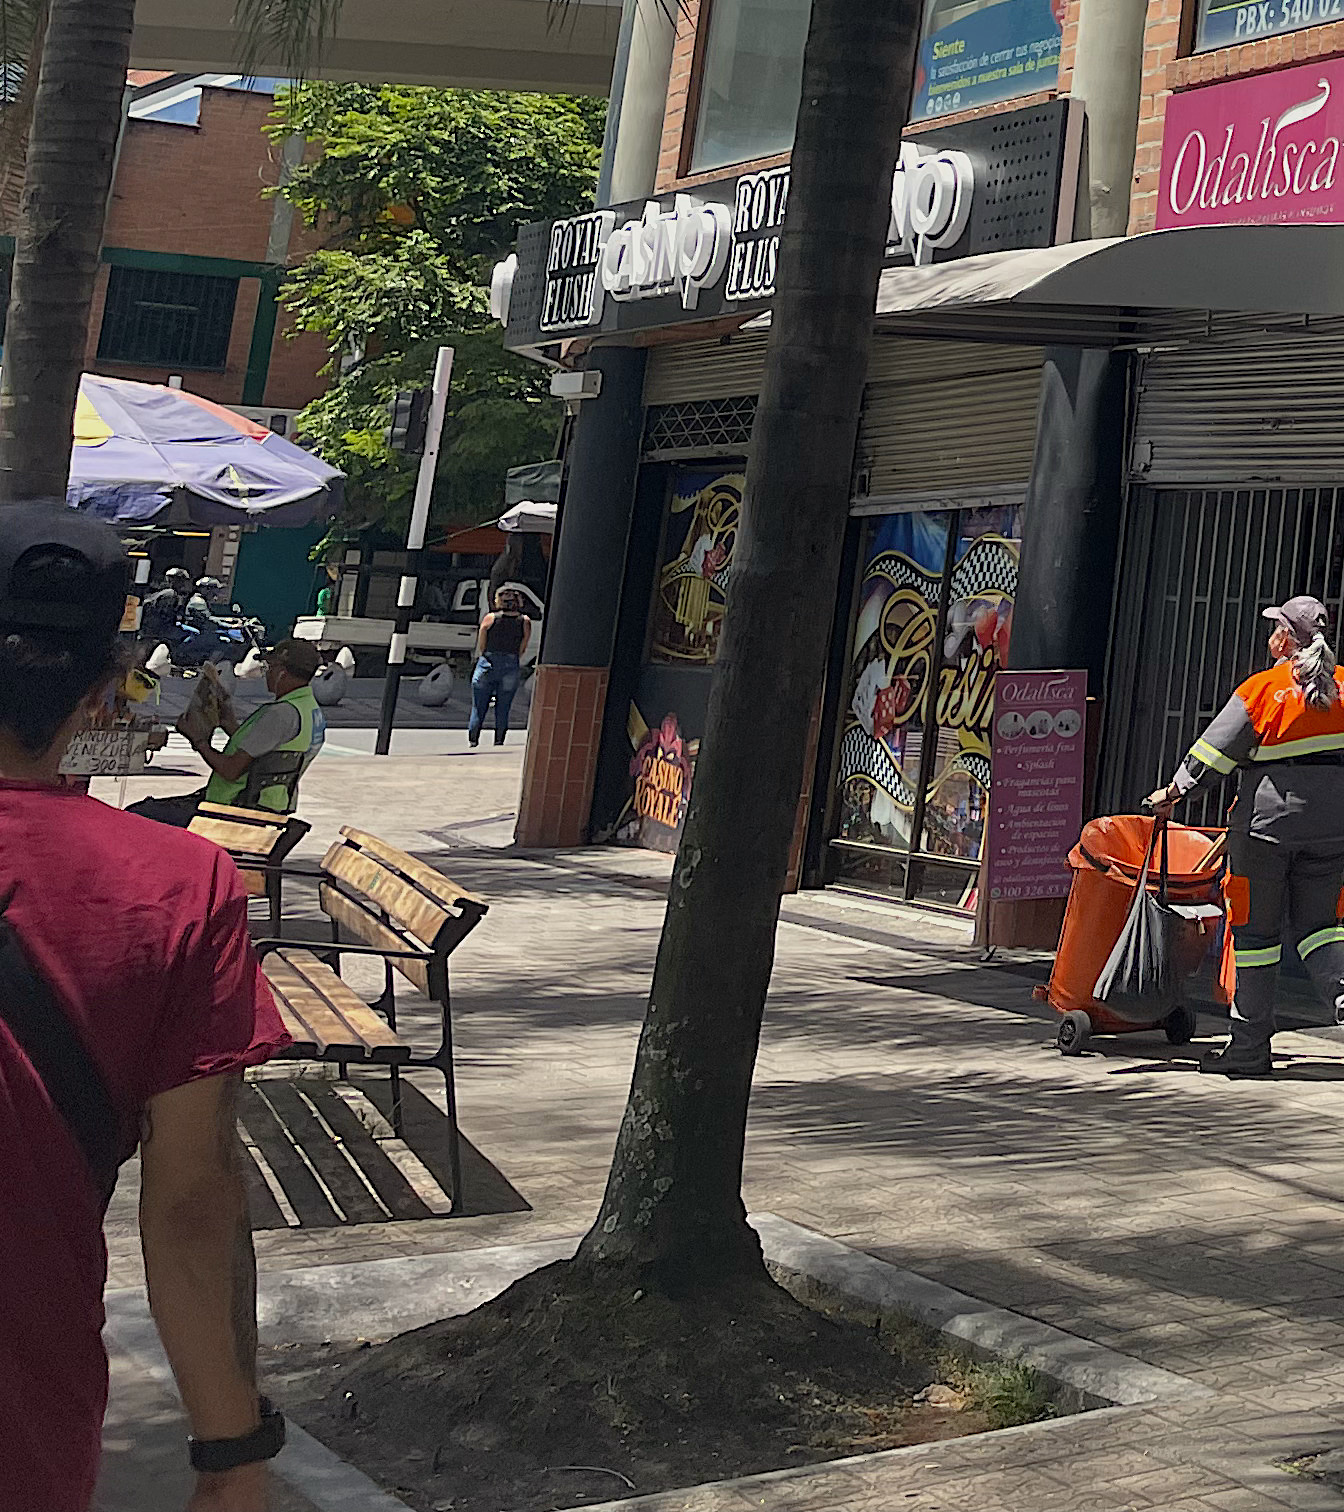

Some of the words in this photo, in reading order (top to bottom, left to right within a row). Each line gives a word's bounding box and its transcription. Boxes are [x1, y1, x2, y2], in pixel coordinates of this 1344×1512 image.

[1235, 2, 1275, 38] PBX:
[932, 39, 965, 60] Siente
[1008, 61, 1024, 76] sala
[1025, 58, 1036, 72] de
[1170, 100, 1344, 214] Odalisca
[552, 219, 600, 271] ROYAL
[602, 201, 718, 290] CASINO
[543, 268, 595, 326] FLUSH
[1002, 677, 1074, 702] Odalisca
[642, 755, 683, 796] CASINO
[633, 774, 683, 829] ROYALE
